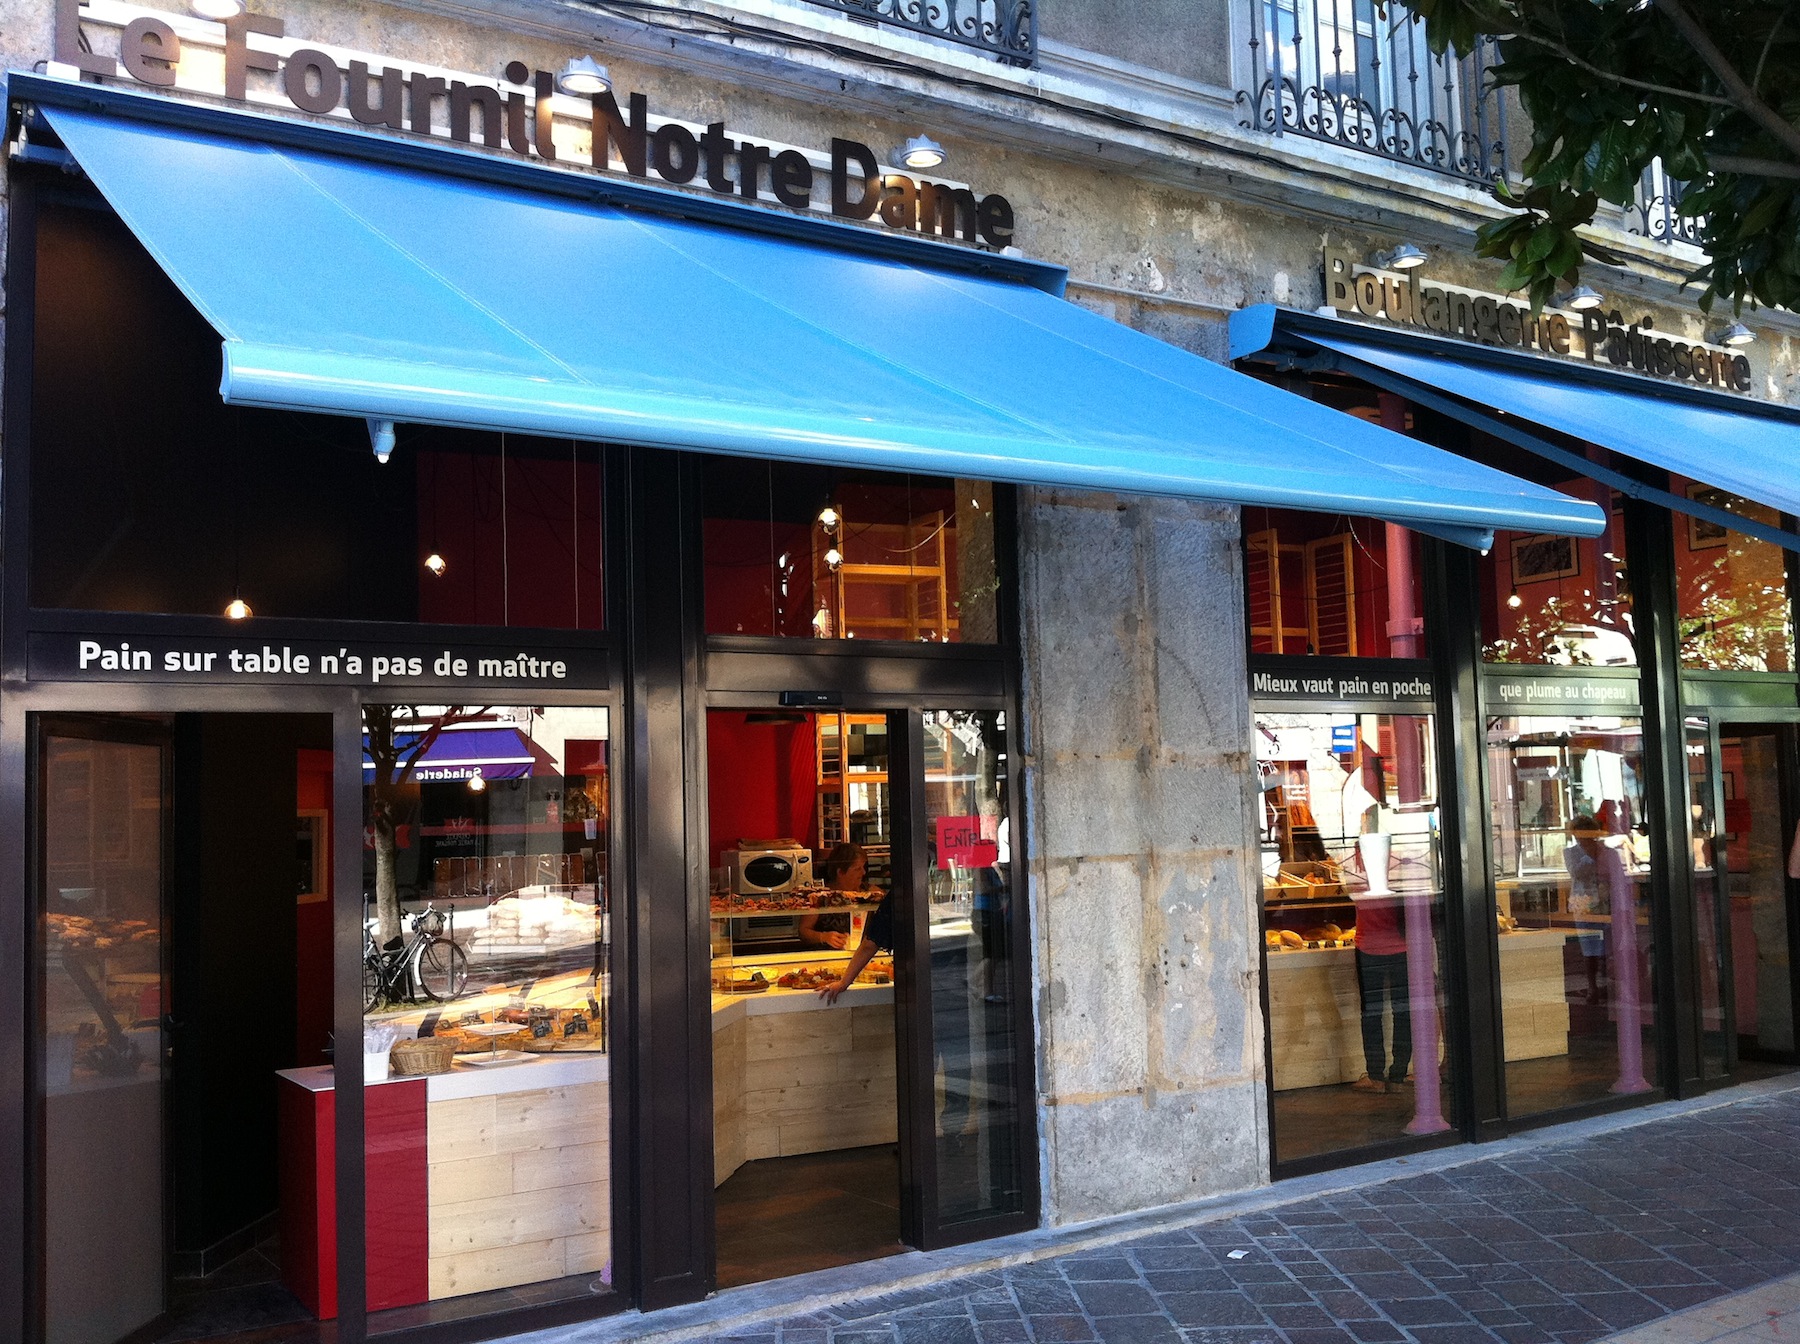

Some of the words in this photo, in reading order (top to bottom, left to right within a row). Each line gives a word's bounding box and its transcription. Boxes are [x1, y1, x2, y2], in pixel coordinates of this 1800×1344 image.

[54, 0, 180, 86] Le
[224, 12, 556, 160] Fournil
[591, 86, 813, 208] Notre
[832, 137, 1015, 247] Dame
[1323, 246, 1570, 354] Boulangerie
[1583, 307, 1751, 391] Pâtisserie
[79, 641, 152, 670] Pain
[164, 650, 217, 672] sur
[229, 646, 310, 674] table
[372, 655, 423, 683] pas
[434, 651, 468, 676] de
[478, 653, 567, 678] maître
[1253, 673, 1299, 693] Mieux
[1302, 678, 1334, 694] vaut
[1339, 676, 1369, 699] pain
[1372, 681, 1389, 695] en
[1392, 677, 1432, 700] poche
[1500, 684, 1522, 702] que
[1526, 681, 1562, 702] plume
[1565, 686, 1579, 698] au
[1581, 682, 1626, 702] chapeau
